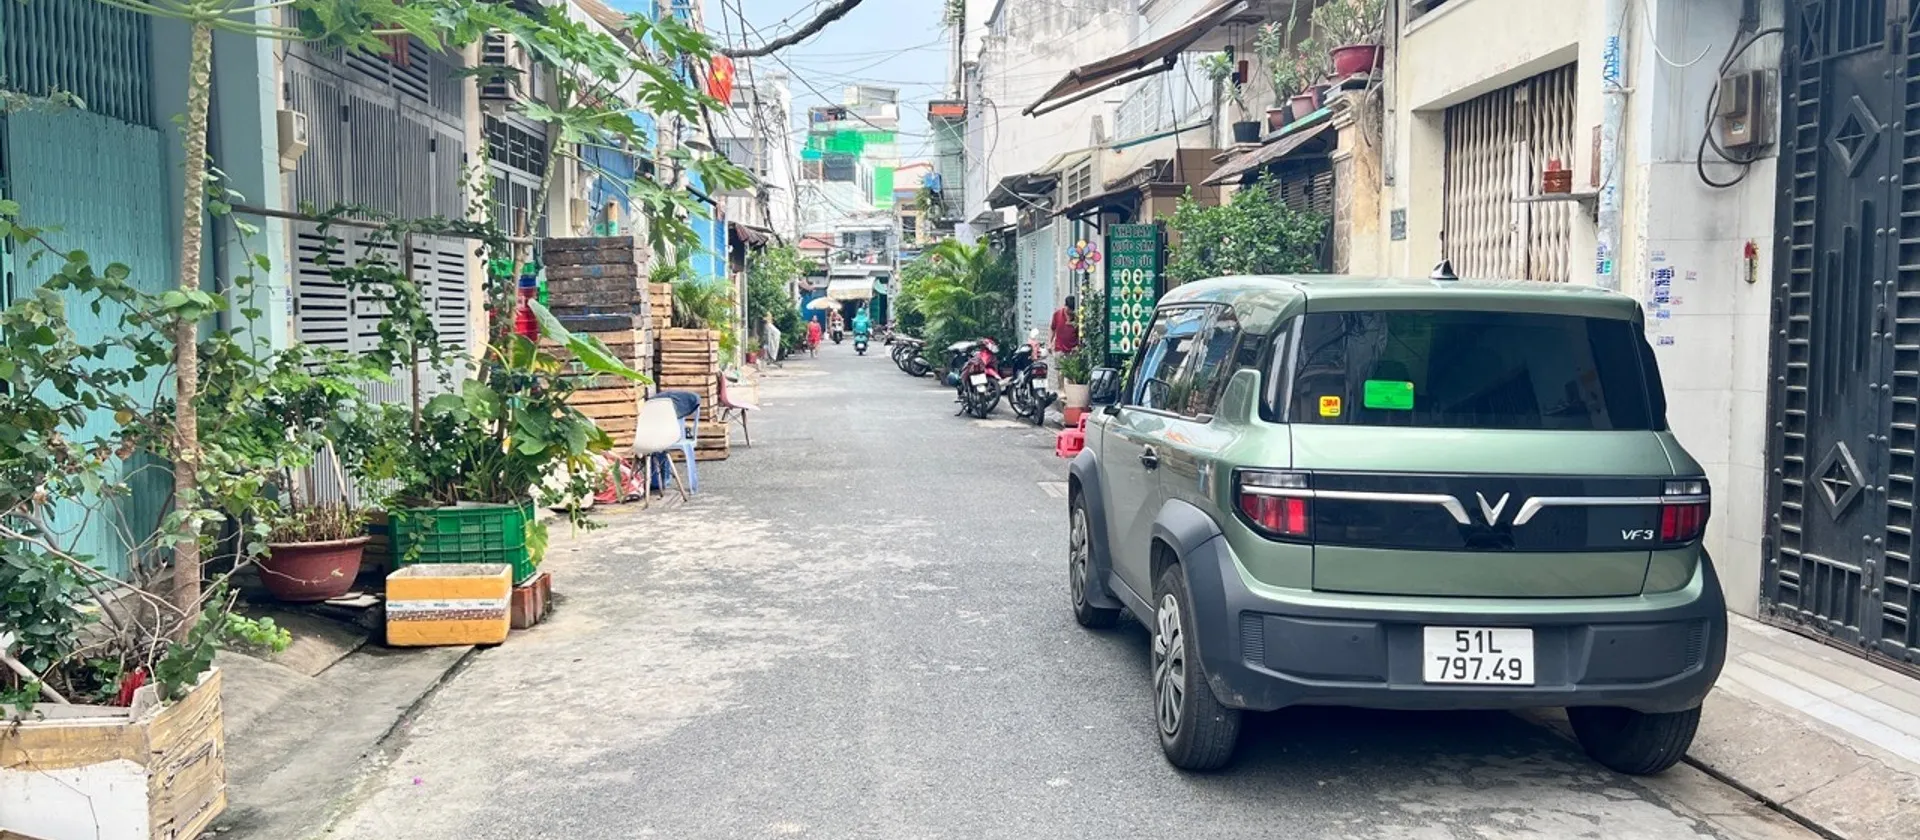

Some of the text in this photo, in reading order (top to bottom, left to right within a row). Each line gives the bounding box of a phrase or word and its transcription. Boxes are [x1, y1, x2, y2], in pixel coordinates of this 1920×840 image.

[1323, 399, 1338, 407] 3M
[1456, 630, 1502, 653] 51L
[1437, 656, 1522, 681] 797.49
